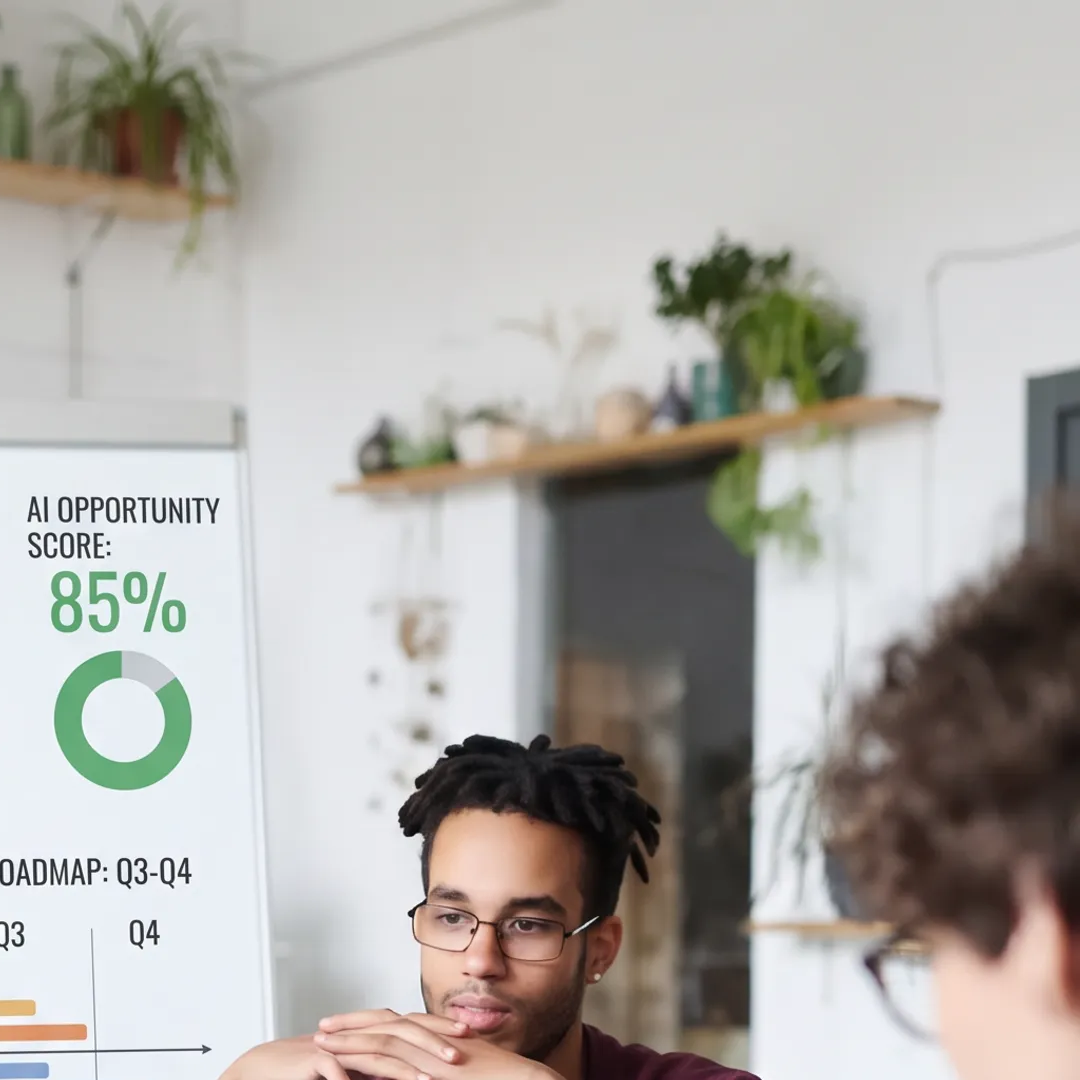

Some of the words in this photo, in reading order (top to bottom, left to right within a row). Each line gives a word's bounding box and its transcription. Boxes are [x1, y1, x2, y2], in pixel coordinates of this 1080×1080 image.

[26, 495, 50, 524] AI
[57, 496, 221, 525] OPPORTUNITY
[27, 531, 112, 560] SCORE:
[50, 570, 187, 634] 85%
[116, 856, 193, 890] Q3-Q4
[129, 918, 161, 951] Q4
